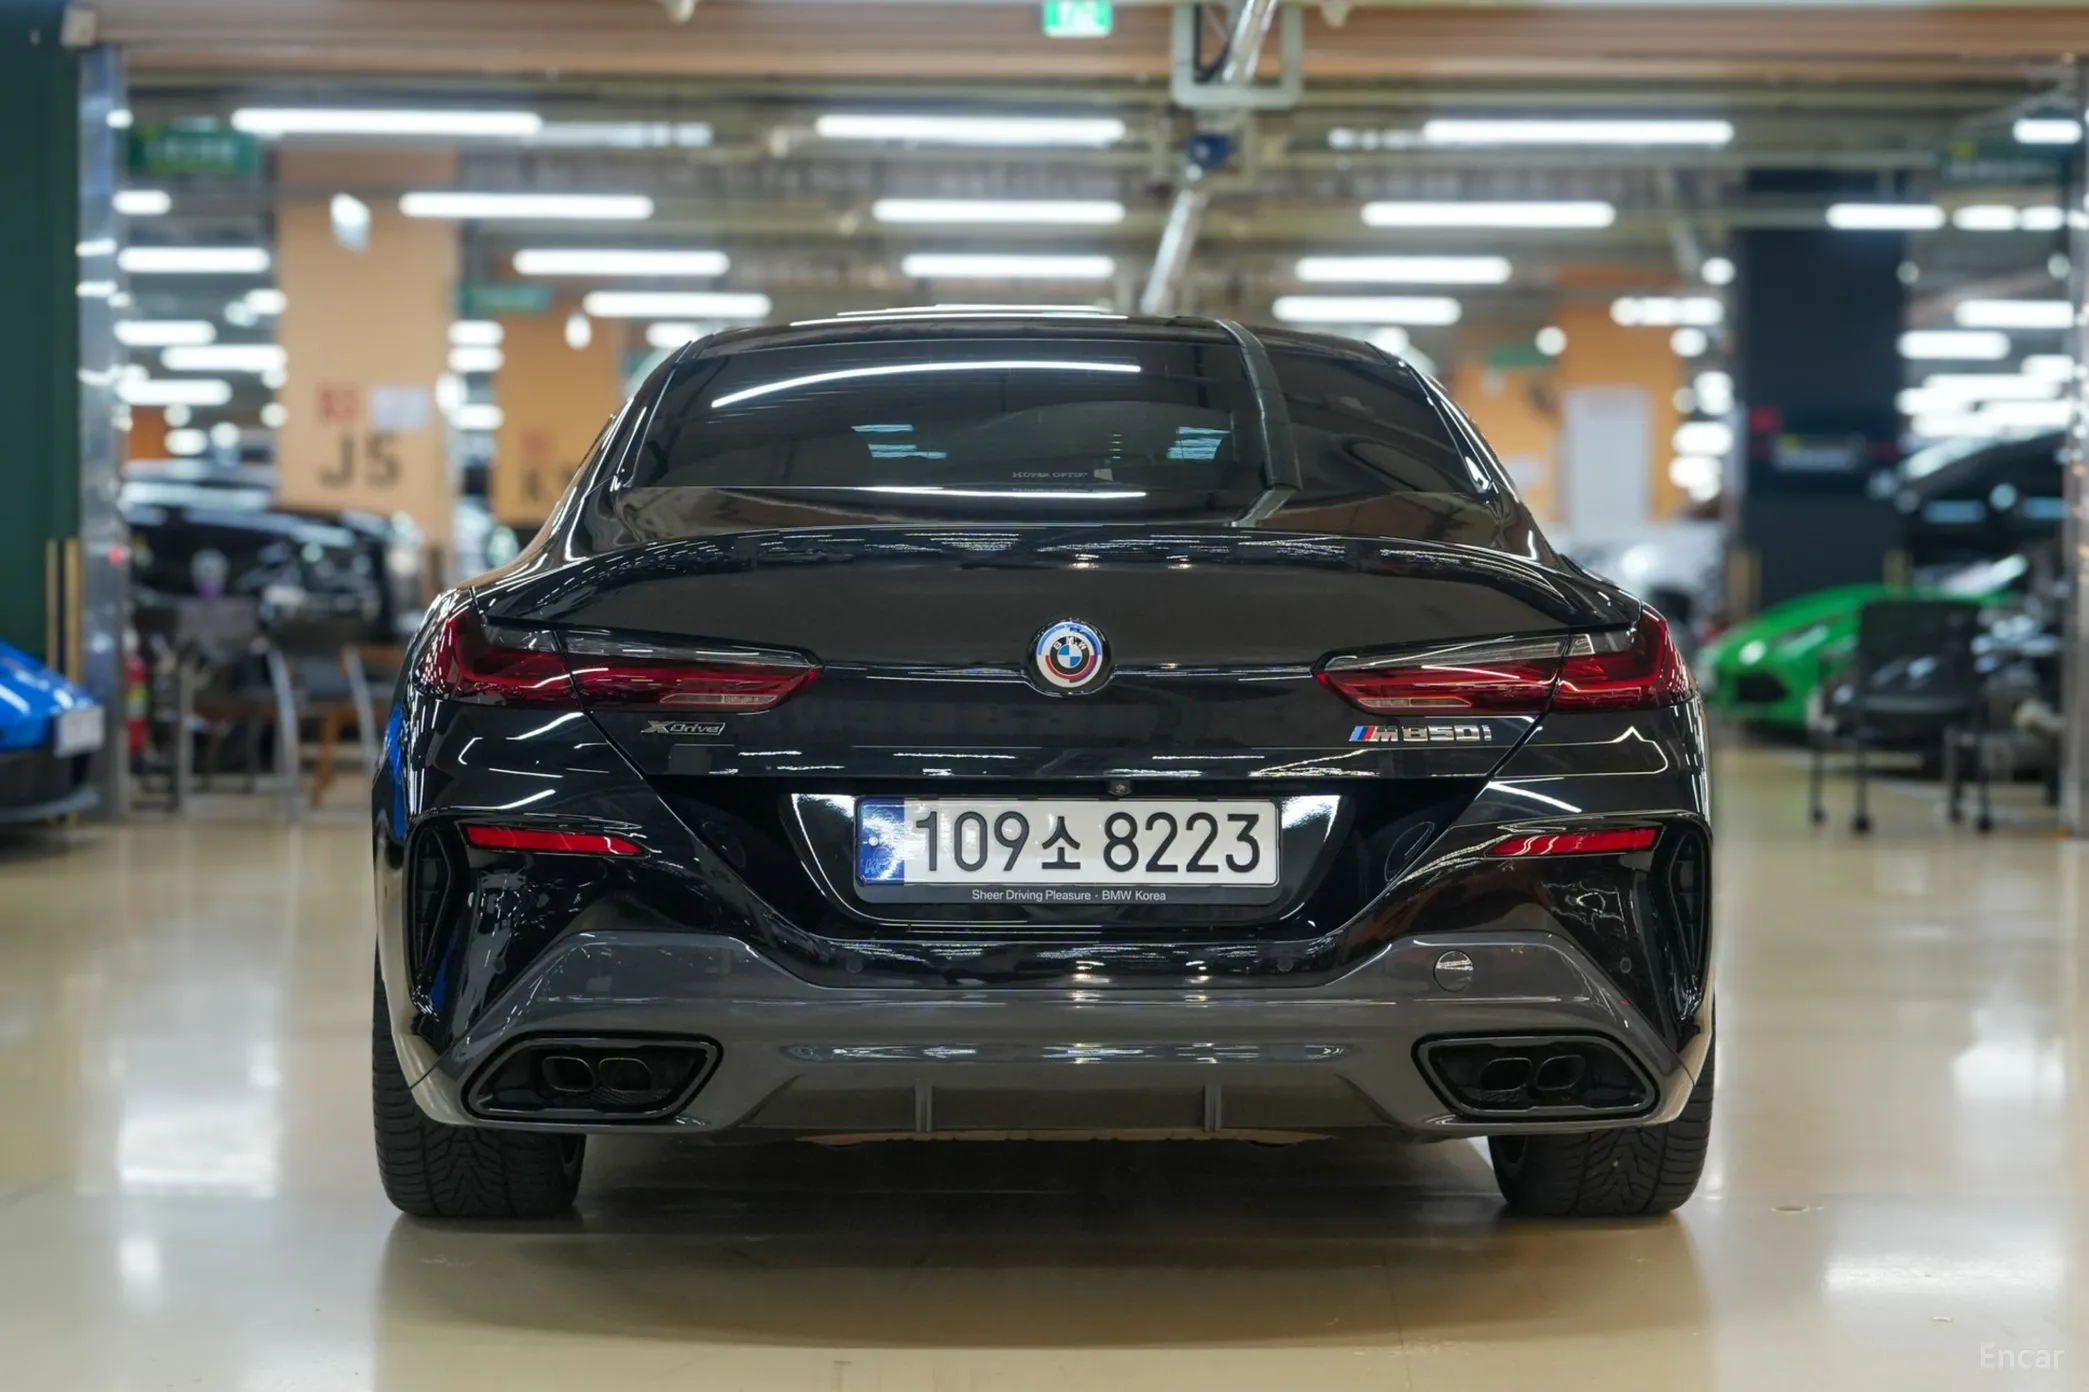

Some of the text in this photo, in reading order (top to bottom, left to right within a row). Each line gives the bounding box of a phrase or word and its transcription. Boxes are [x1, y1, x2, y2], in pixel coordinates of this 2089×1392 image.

[1103, 811, 1261, 873] 8223
[971, 888, 1166, 902] Sheer Driving Pleasure BMW Korea
